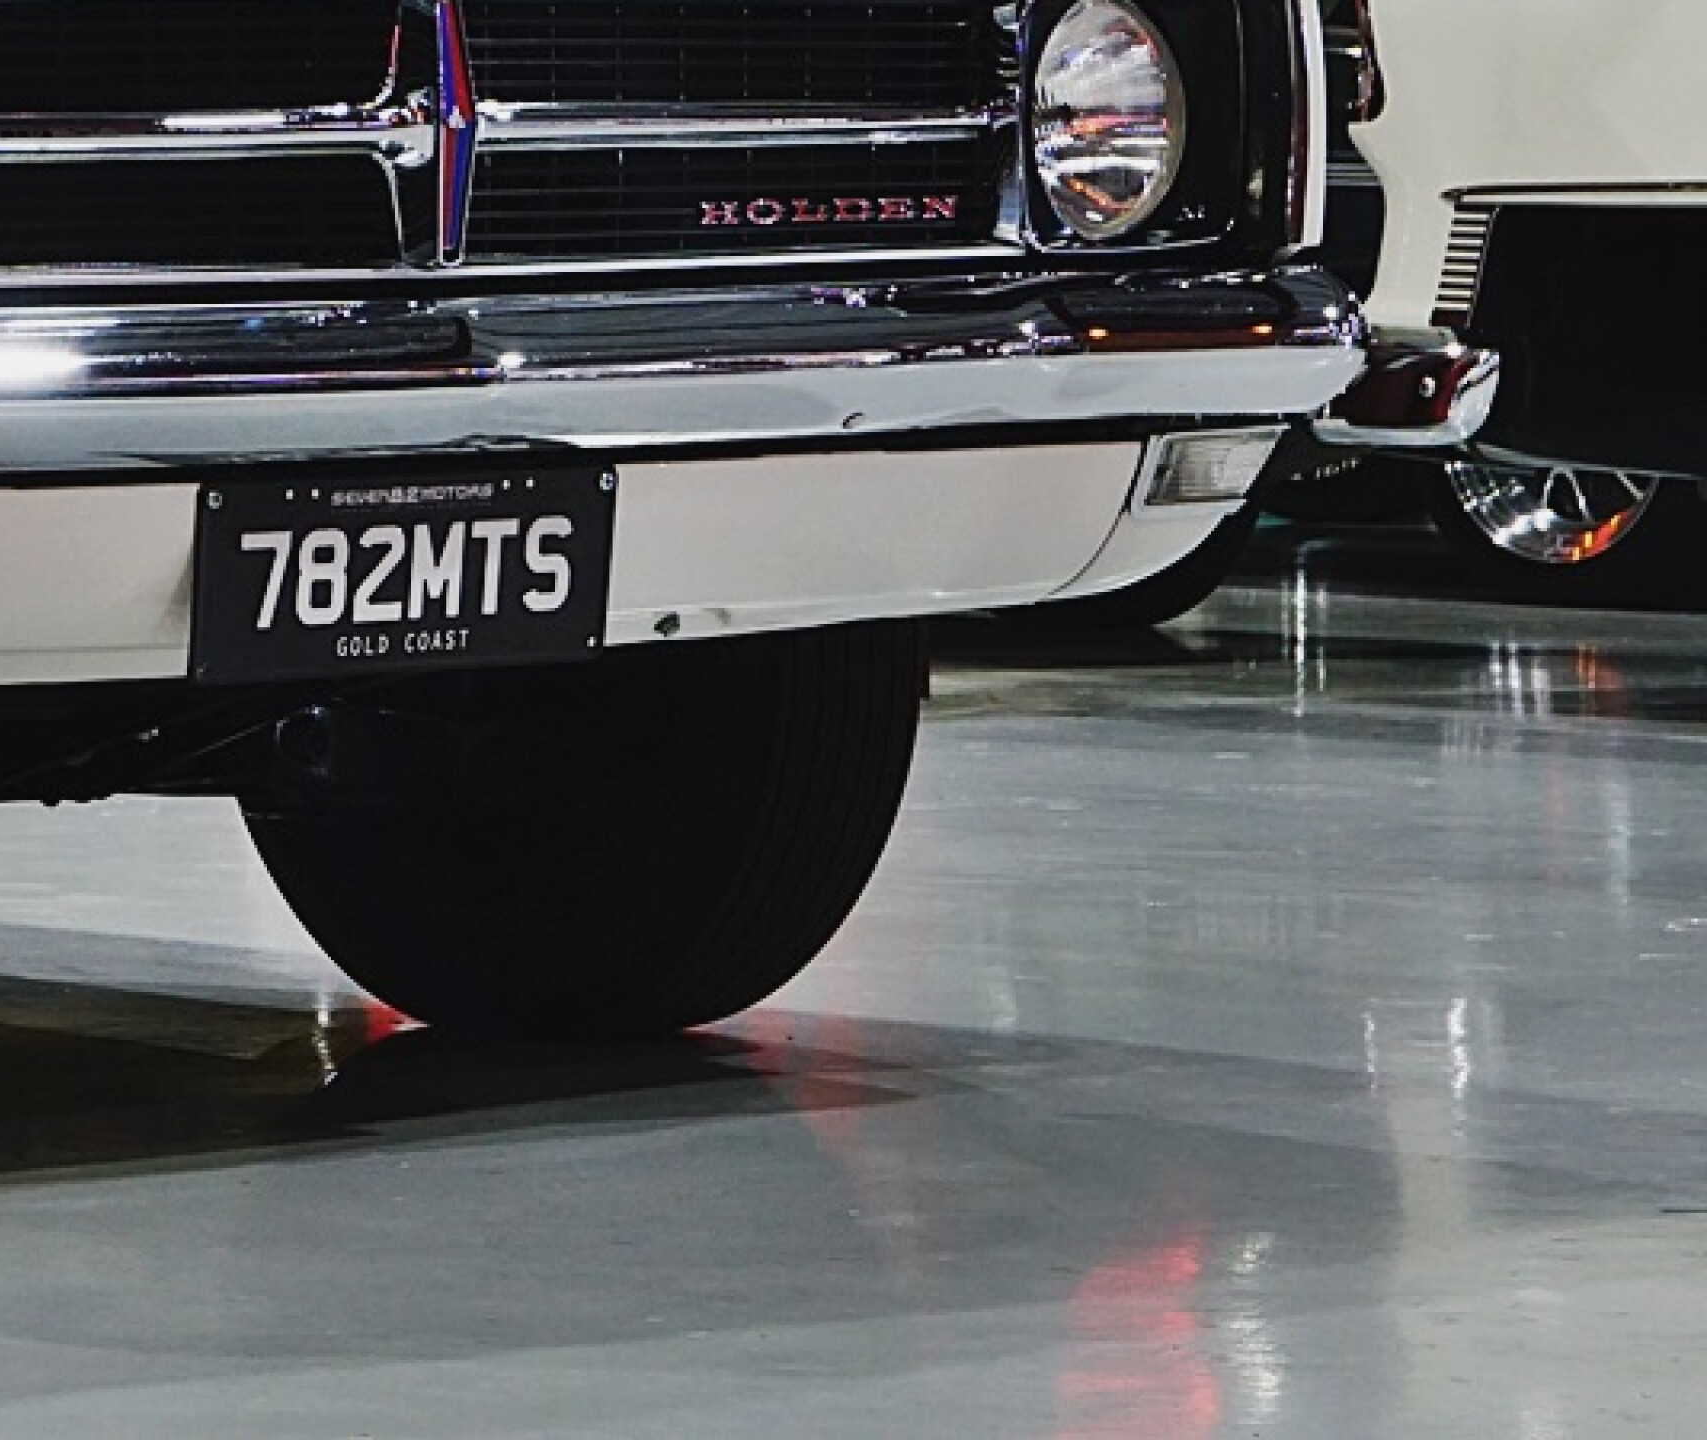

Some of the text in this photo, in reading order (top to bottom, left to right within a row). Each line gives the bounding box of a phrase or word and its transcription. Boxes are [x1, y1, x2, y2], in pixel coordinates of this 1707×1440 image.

[698, 195, 958, 225] HOLDEN
[239, 514, 575, 632] 782MTS
[336, 629, 471, 657] GOLD COAST
